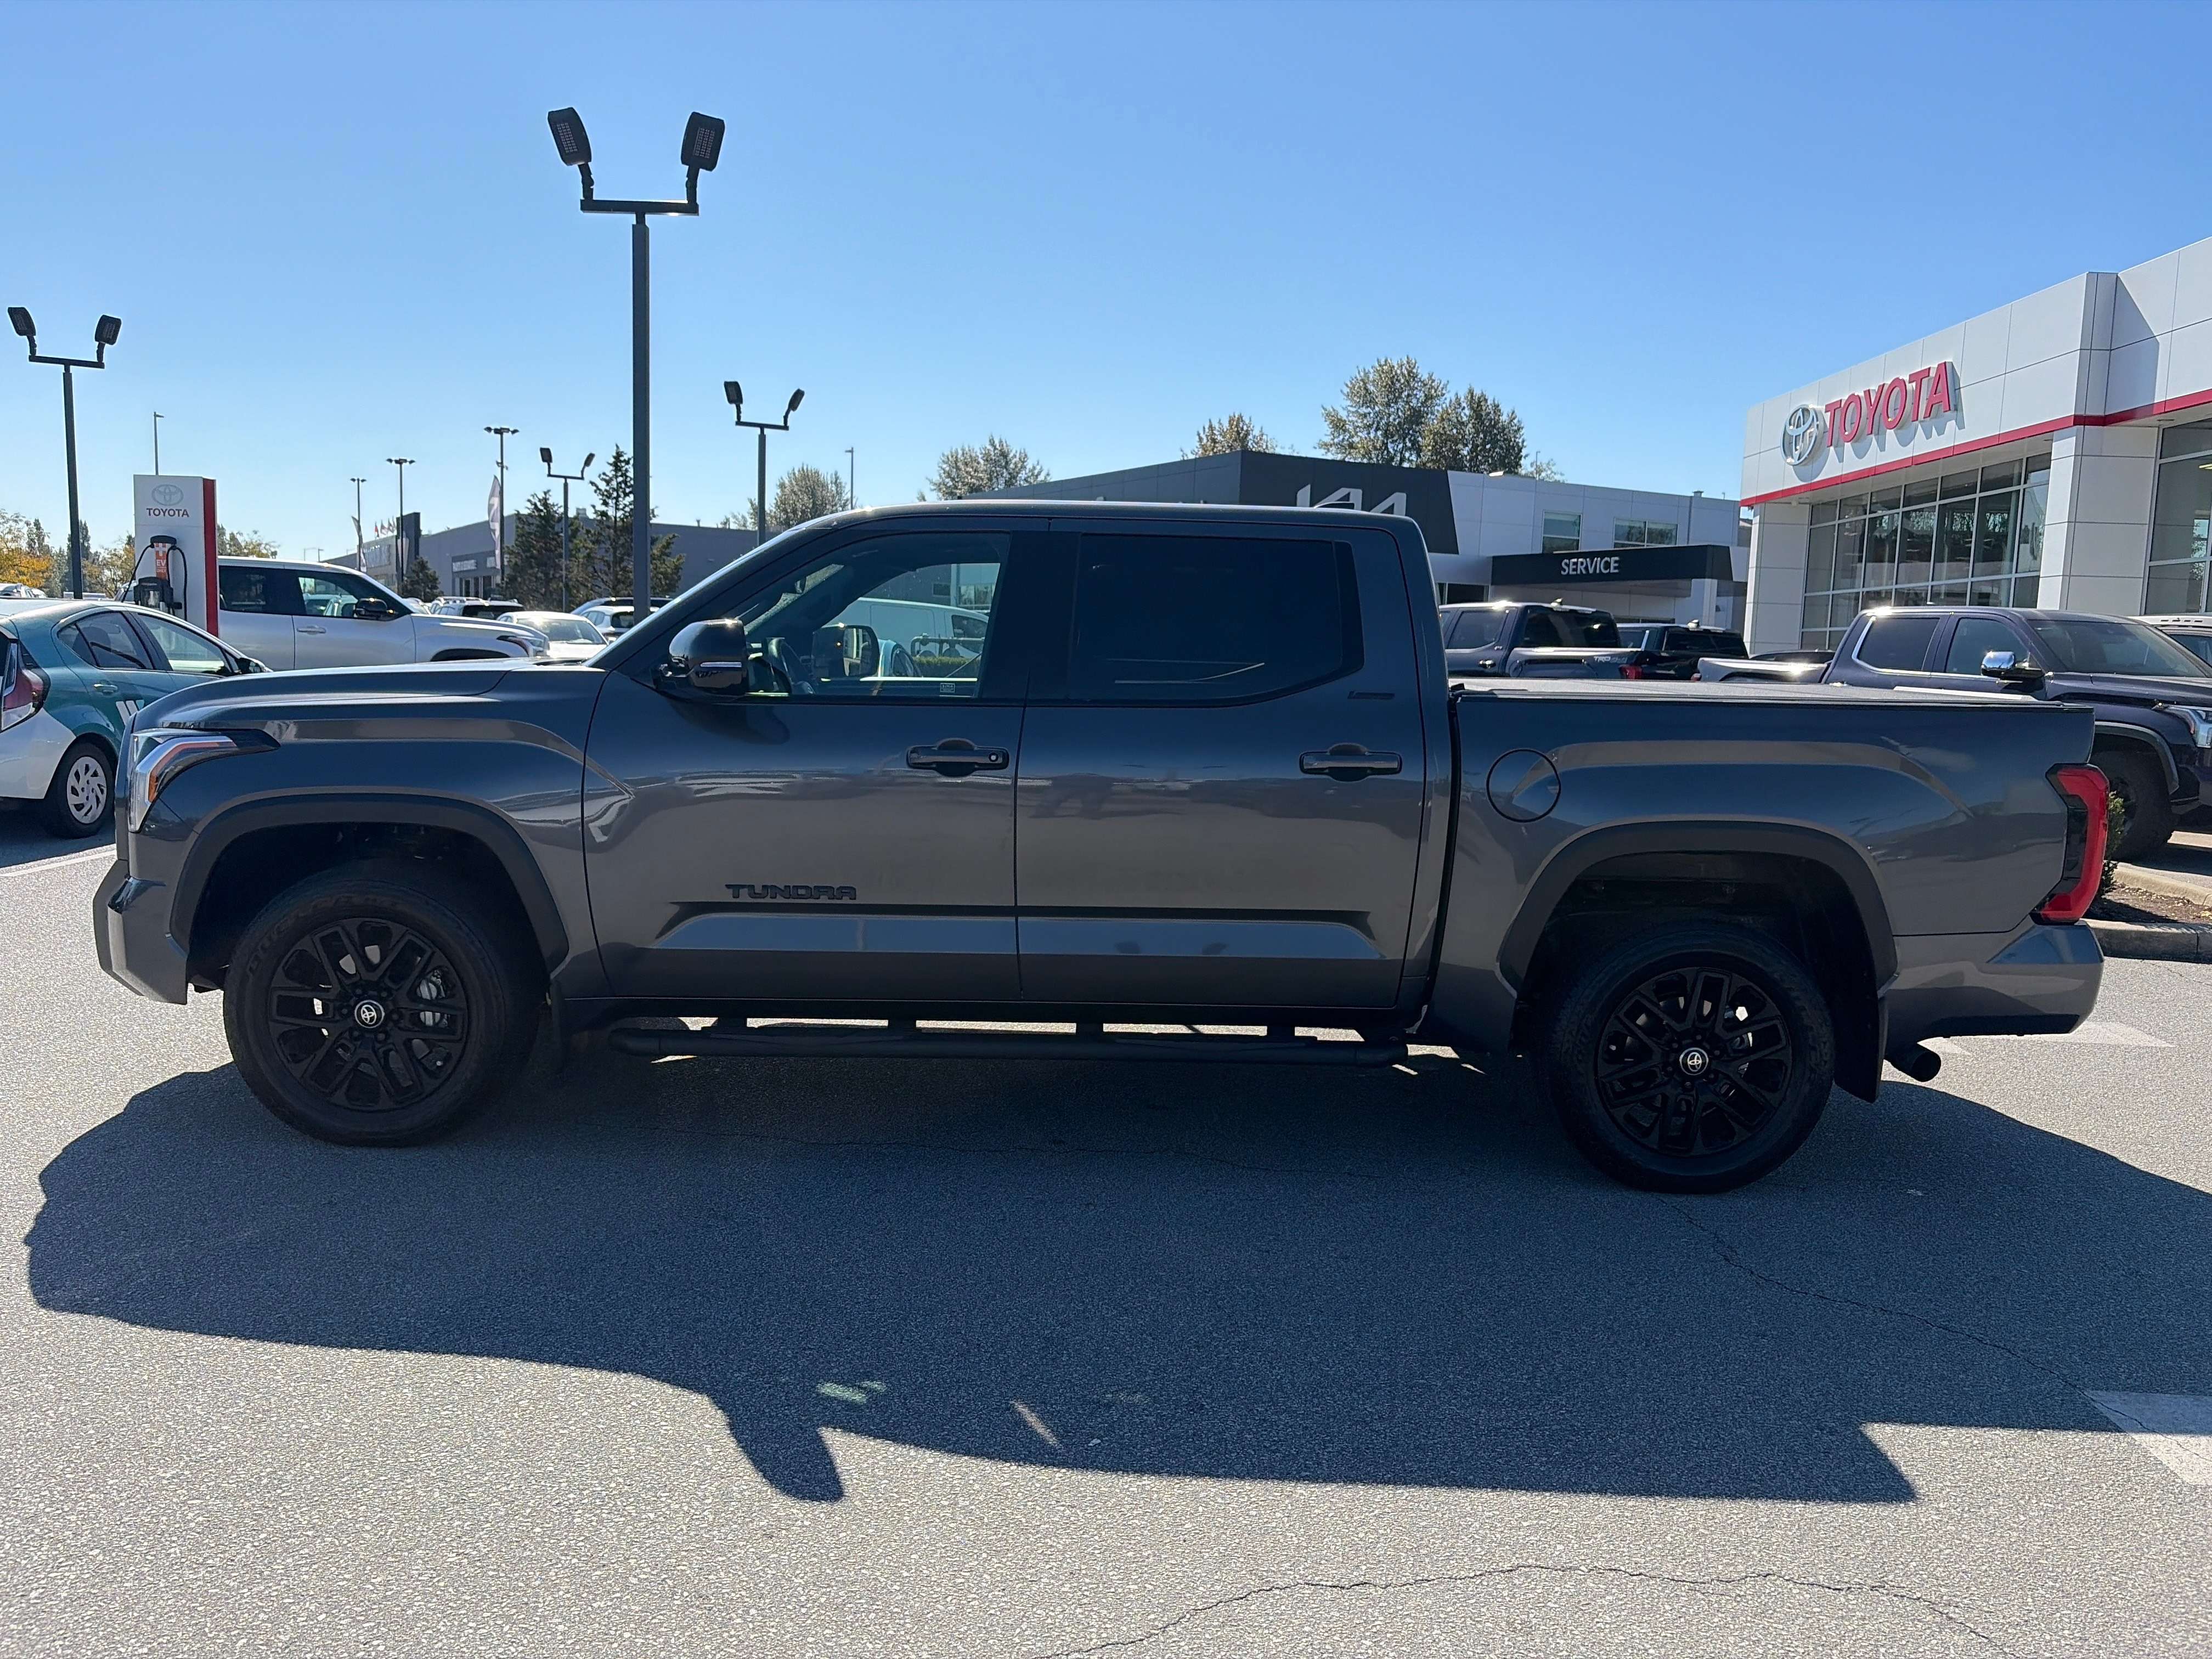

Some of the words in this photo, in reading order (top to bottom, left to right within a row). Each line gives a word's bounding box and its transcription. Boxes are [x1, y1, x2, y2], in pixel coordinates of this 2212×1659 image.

[1825, 361, 1951, 448] TOYOTA
[146, 508, 189, 517] TOYOTA
[1561, 556, 1620, 575] SERVICE
[725, 884, 856, 900] TUNDRA
